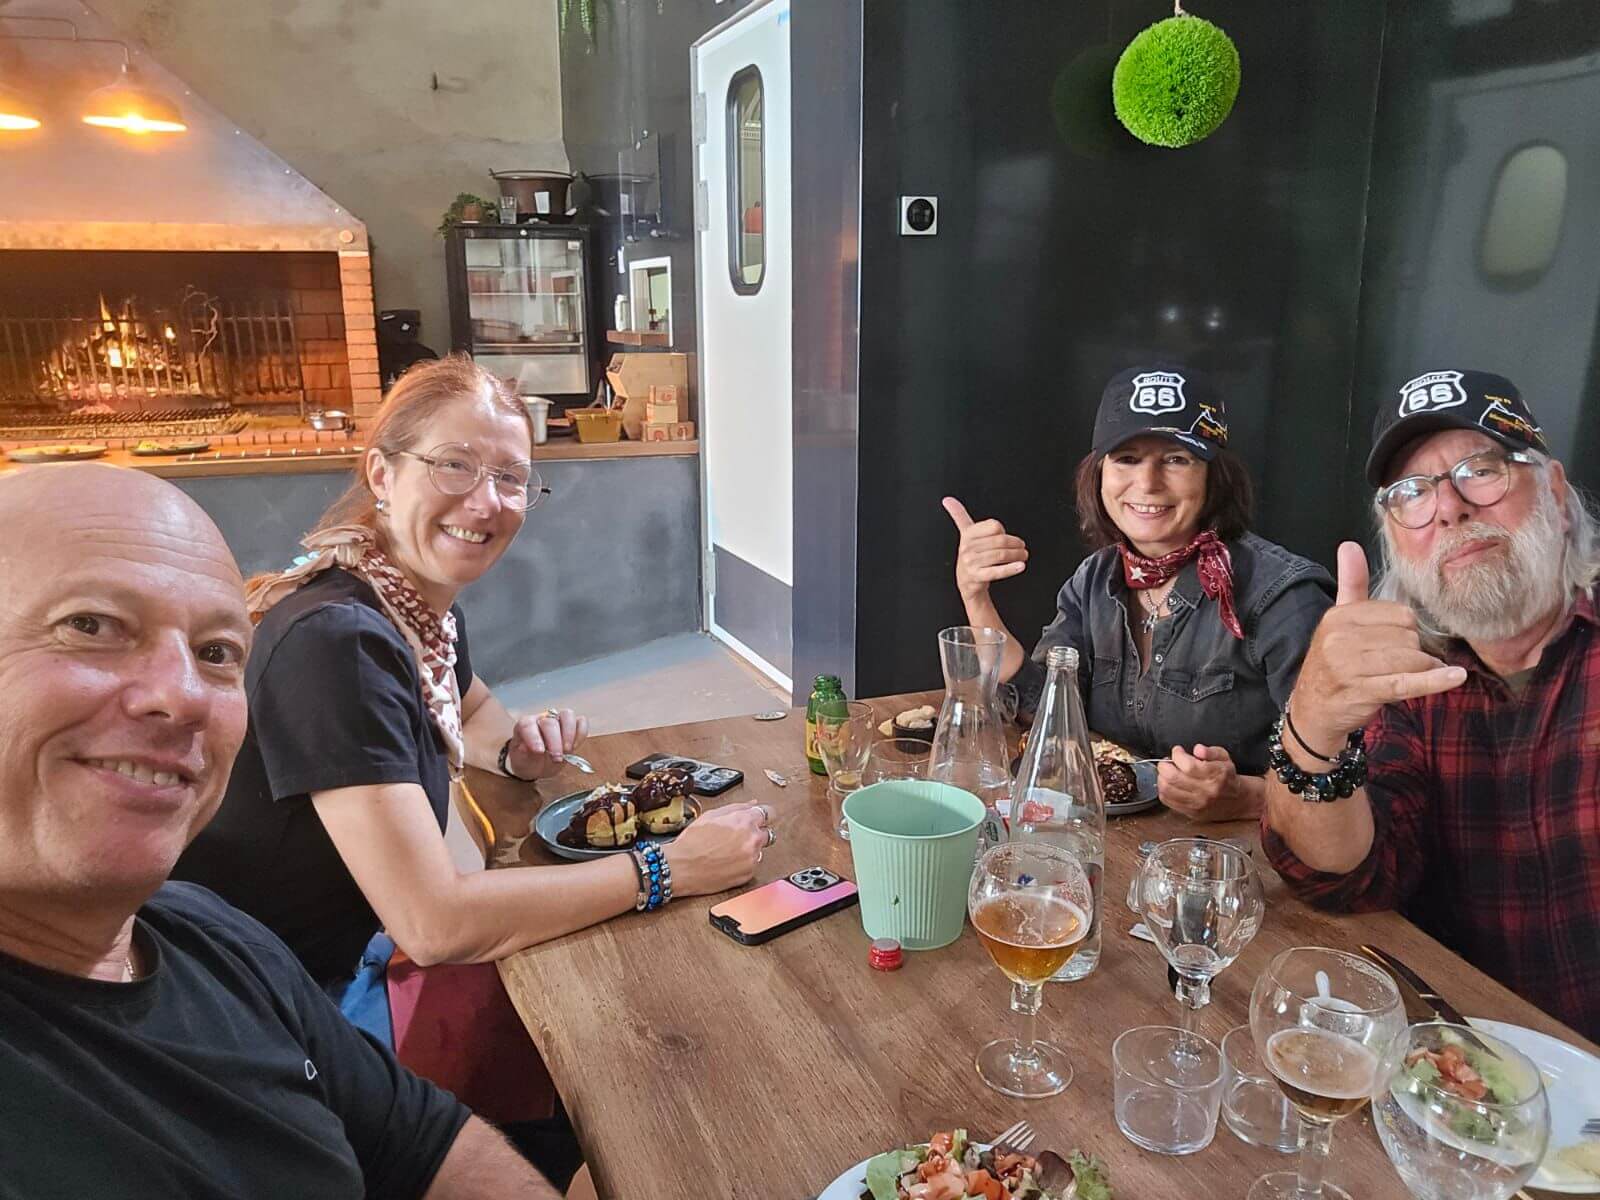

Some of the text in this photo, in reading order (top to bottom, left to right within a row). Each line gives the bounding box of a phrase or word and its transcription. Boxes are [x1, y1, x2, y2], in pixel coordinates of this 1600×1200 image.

[1143, 375, 1175, 384] ROUTE
[1139, 387, 1176, 407] 66
[1408, 383, 1453, 411] 66
